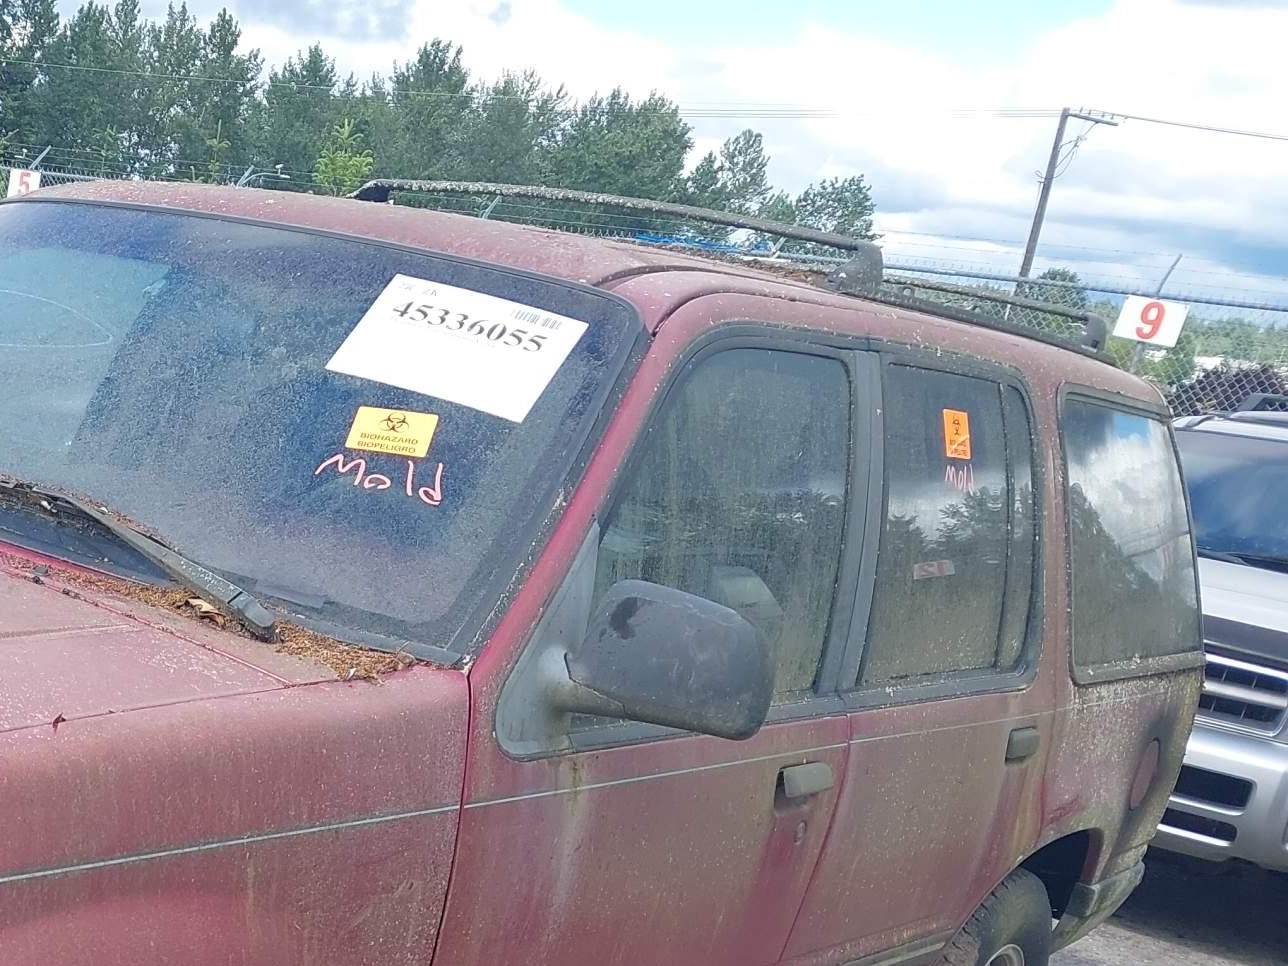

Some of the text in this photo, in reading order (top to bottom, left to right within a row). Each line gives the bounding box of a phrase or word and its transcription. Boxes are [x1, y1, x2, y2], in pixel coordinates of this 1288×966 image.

[18, 171, 31, 194] 5
[392, 300, 548, 352] 45336055
[1135, 301, 1166, 340] 9
[357, 440, 417, 454] BIOPELIGRO
[359, 432, 419, 446] BIOHAZARD
[314, 453, 444, 507] Mold
